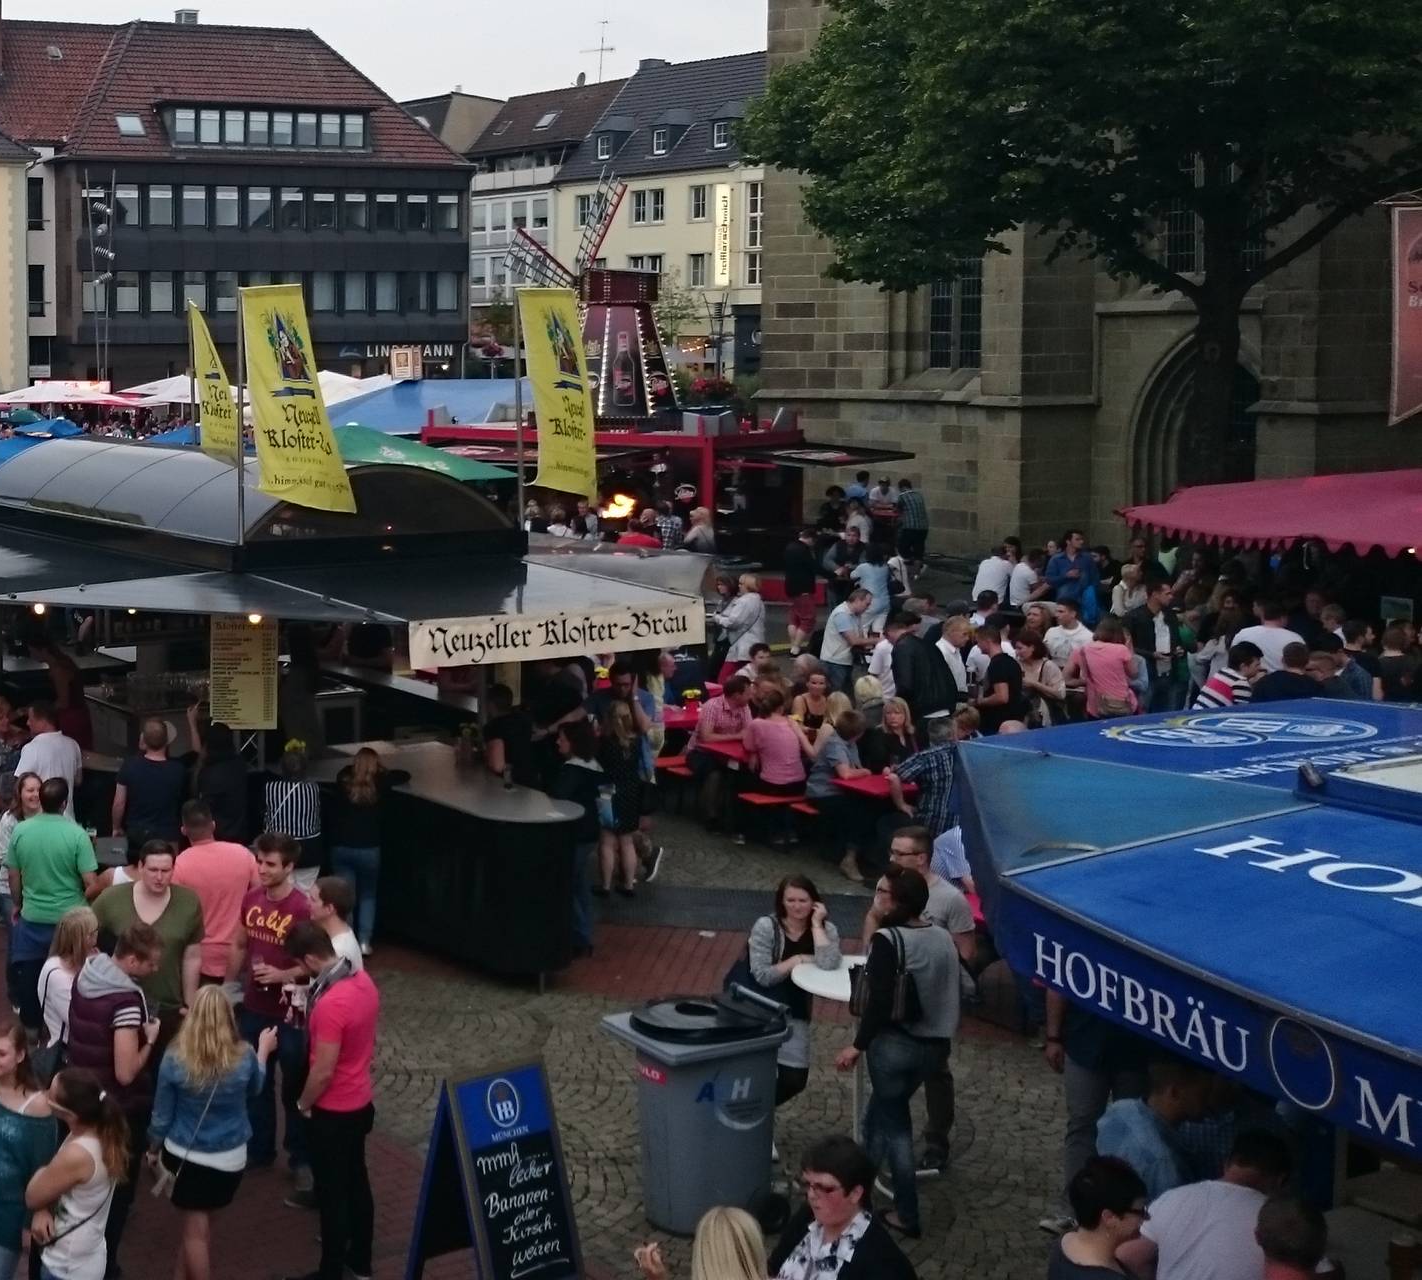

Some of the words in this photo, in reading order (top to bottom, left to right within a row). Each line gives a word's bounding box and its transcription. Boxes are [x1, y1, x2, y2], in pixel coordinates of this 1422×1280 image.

[366, 344, 453, 357] LINANN
[428, 623, 532, 663] Neuzeller
[246, 905, 292, 938] Calif
[1033, 931, 1250, 1073] HOFBRÄU
[495, 1100, 516, 1122] HB
[490, 1124, 529, 1143] MÜNCHEN
[508, 1159, 554, 1189] lecker
[513, 1206, 543, 1226] oder
[512, 1238, 561, 1267] weizen
